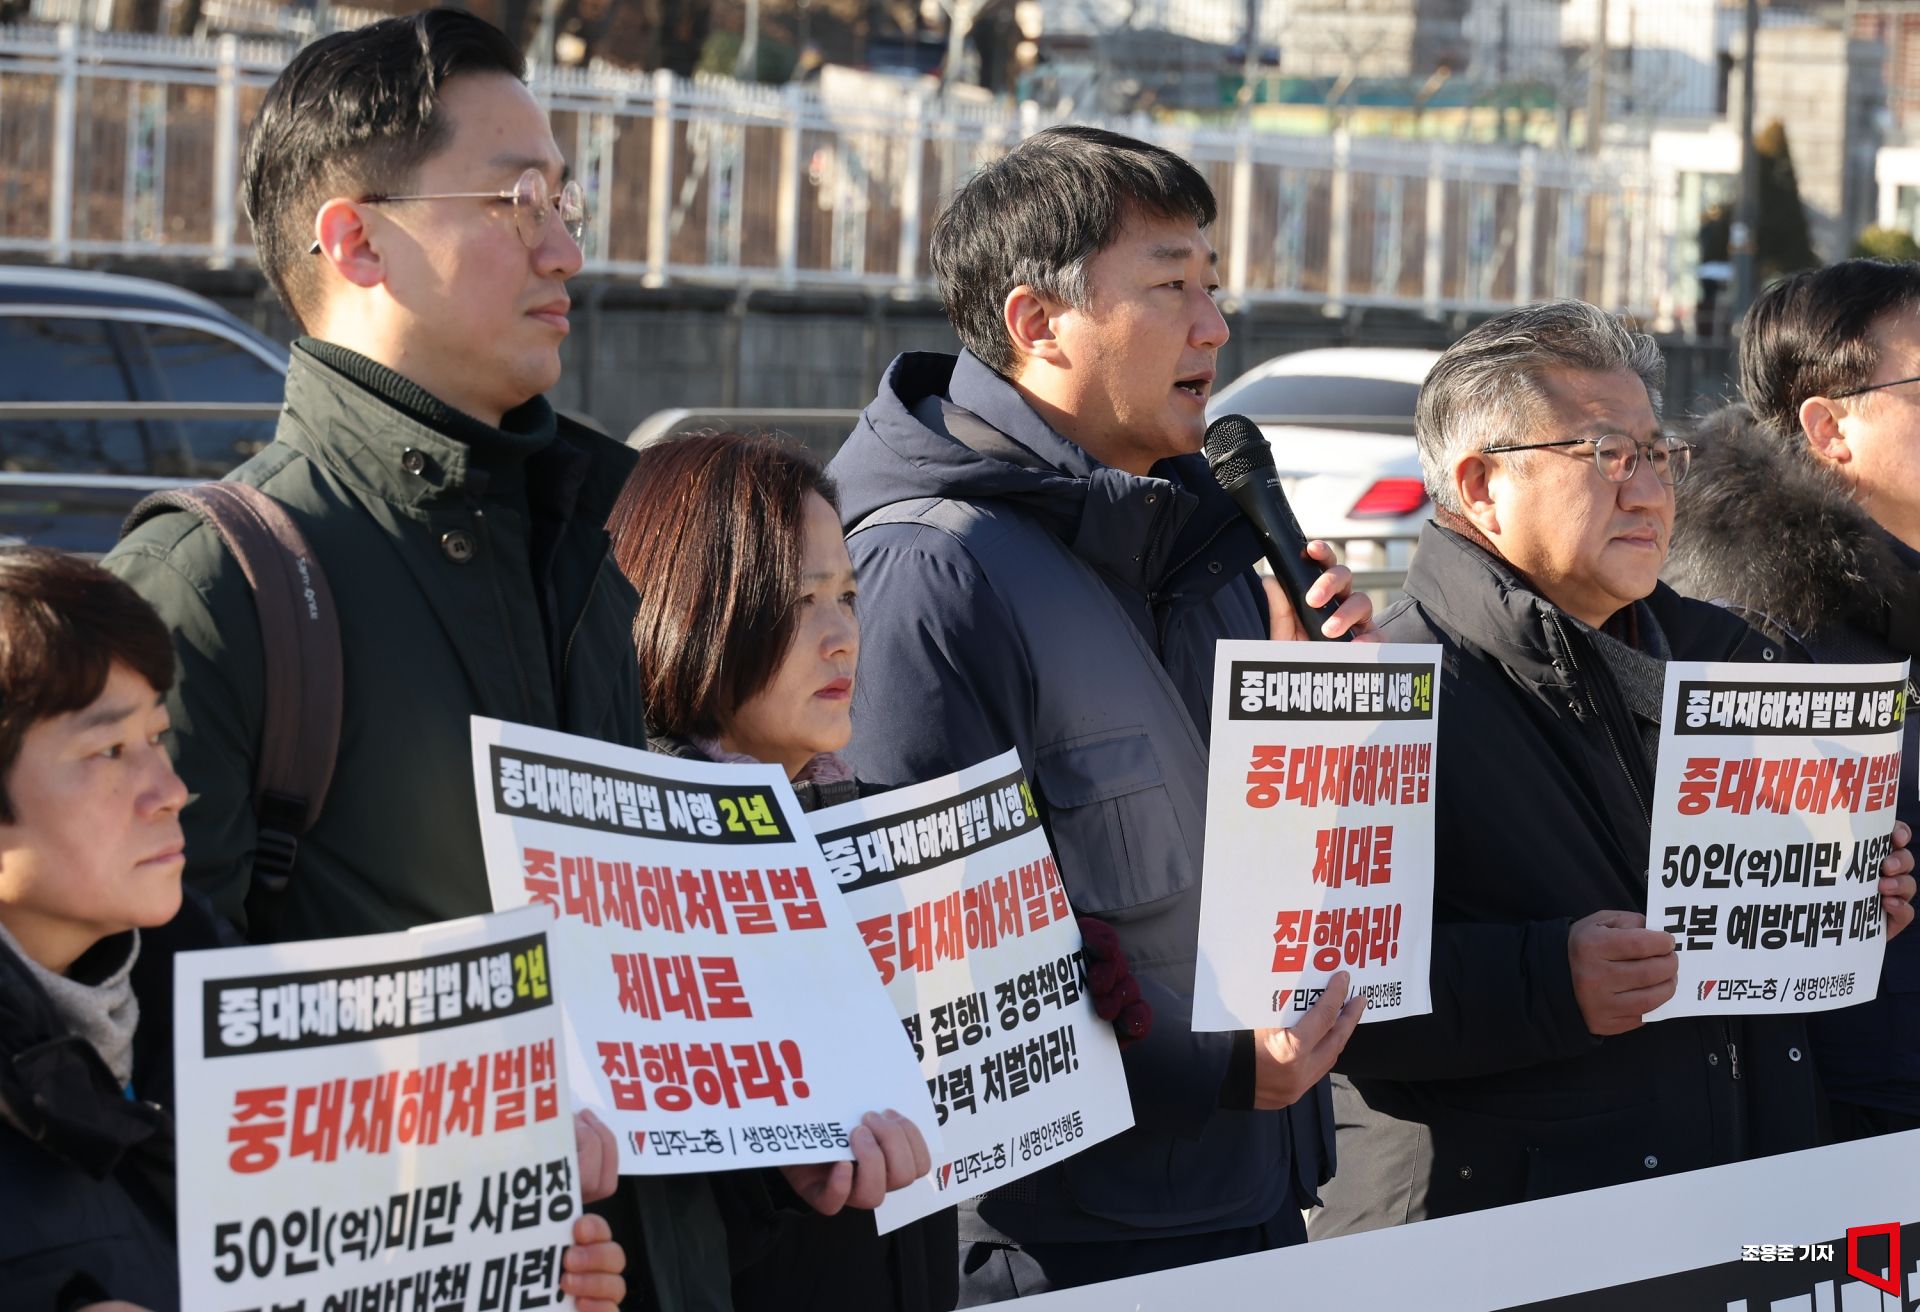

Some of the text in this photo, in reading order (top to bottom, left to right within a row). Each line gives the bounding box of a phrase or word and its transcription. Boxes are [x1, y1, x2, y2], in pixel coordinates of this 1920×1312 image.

[1240, 670, 1431, 713] 중대재해처벌법 시행 2년
[1686, 689, 1856, 729] 중대재해처벌법
[1858, 689, 1894, 728] 시행
[500, 757, 780, 837] 중대재해처벌법 시행 2년
[1245, 742, 1432, 809] 중대재해처벌법
[1677, 751, 1901, 816] 중대재해처벌법
[821, 794, 992, 885] 중대재해처벌법
[990, 782, 1027, 831] 시행
[1312, 825, 1394, 889] 제대로
[1661, 842, 1841, 889] 50인(억)미만
[1271, 903, 1402, 973] 집행하라!
[1726, 901, 1847, 950] 예방대책
[1848, 893, 1882, 943] 마련!
[217, 944, 549, 1047] 중대재해처벌법 시행 2년
[611, 953, 753, 1022] 제대로
[1717, 978, 1778, 1001] 민주노총
[1793, 972, 1856, 1001] 생명안전행동
[930, 991, 992, 1057] 집행!
[596, 1039, 811, 1112] 집행하라!
[980, 1024, 1079, 1104] 처벌하라!
[227, 1037, 559, 1175] 중대재해처벌법
[649, 1128, 725, 1156] 민주노총
[742, 1121, 850, 1154] 생명안전행동
[953, 1142, 1007, 1185] 민주노총
[1018, 1109, 1084, 1162] 생명안전행동
[213, 1156, 574, 1284] 50인(억)미만 사업장
